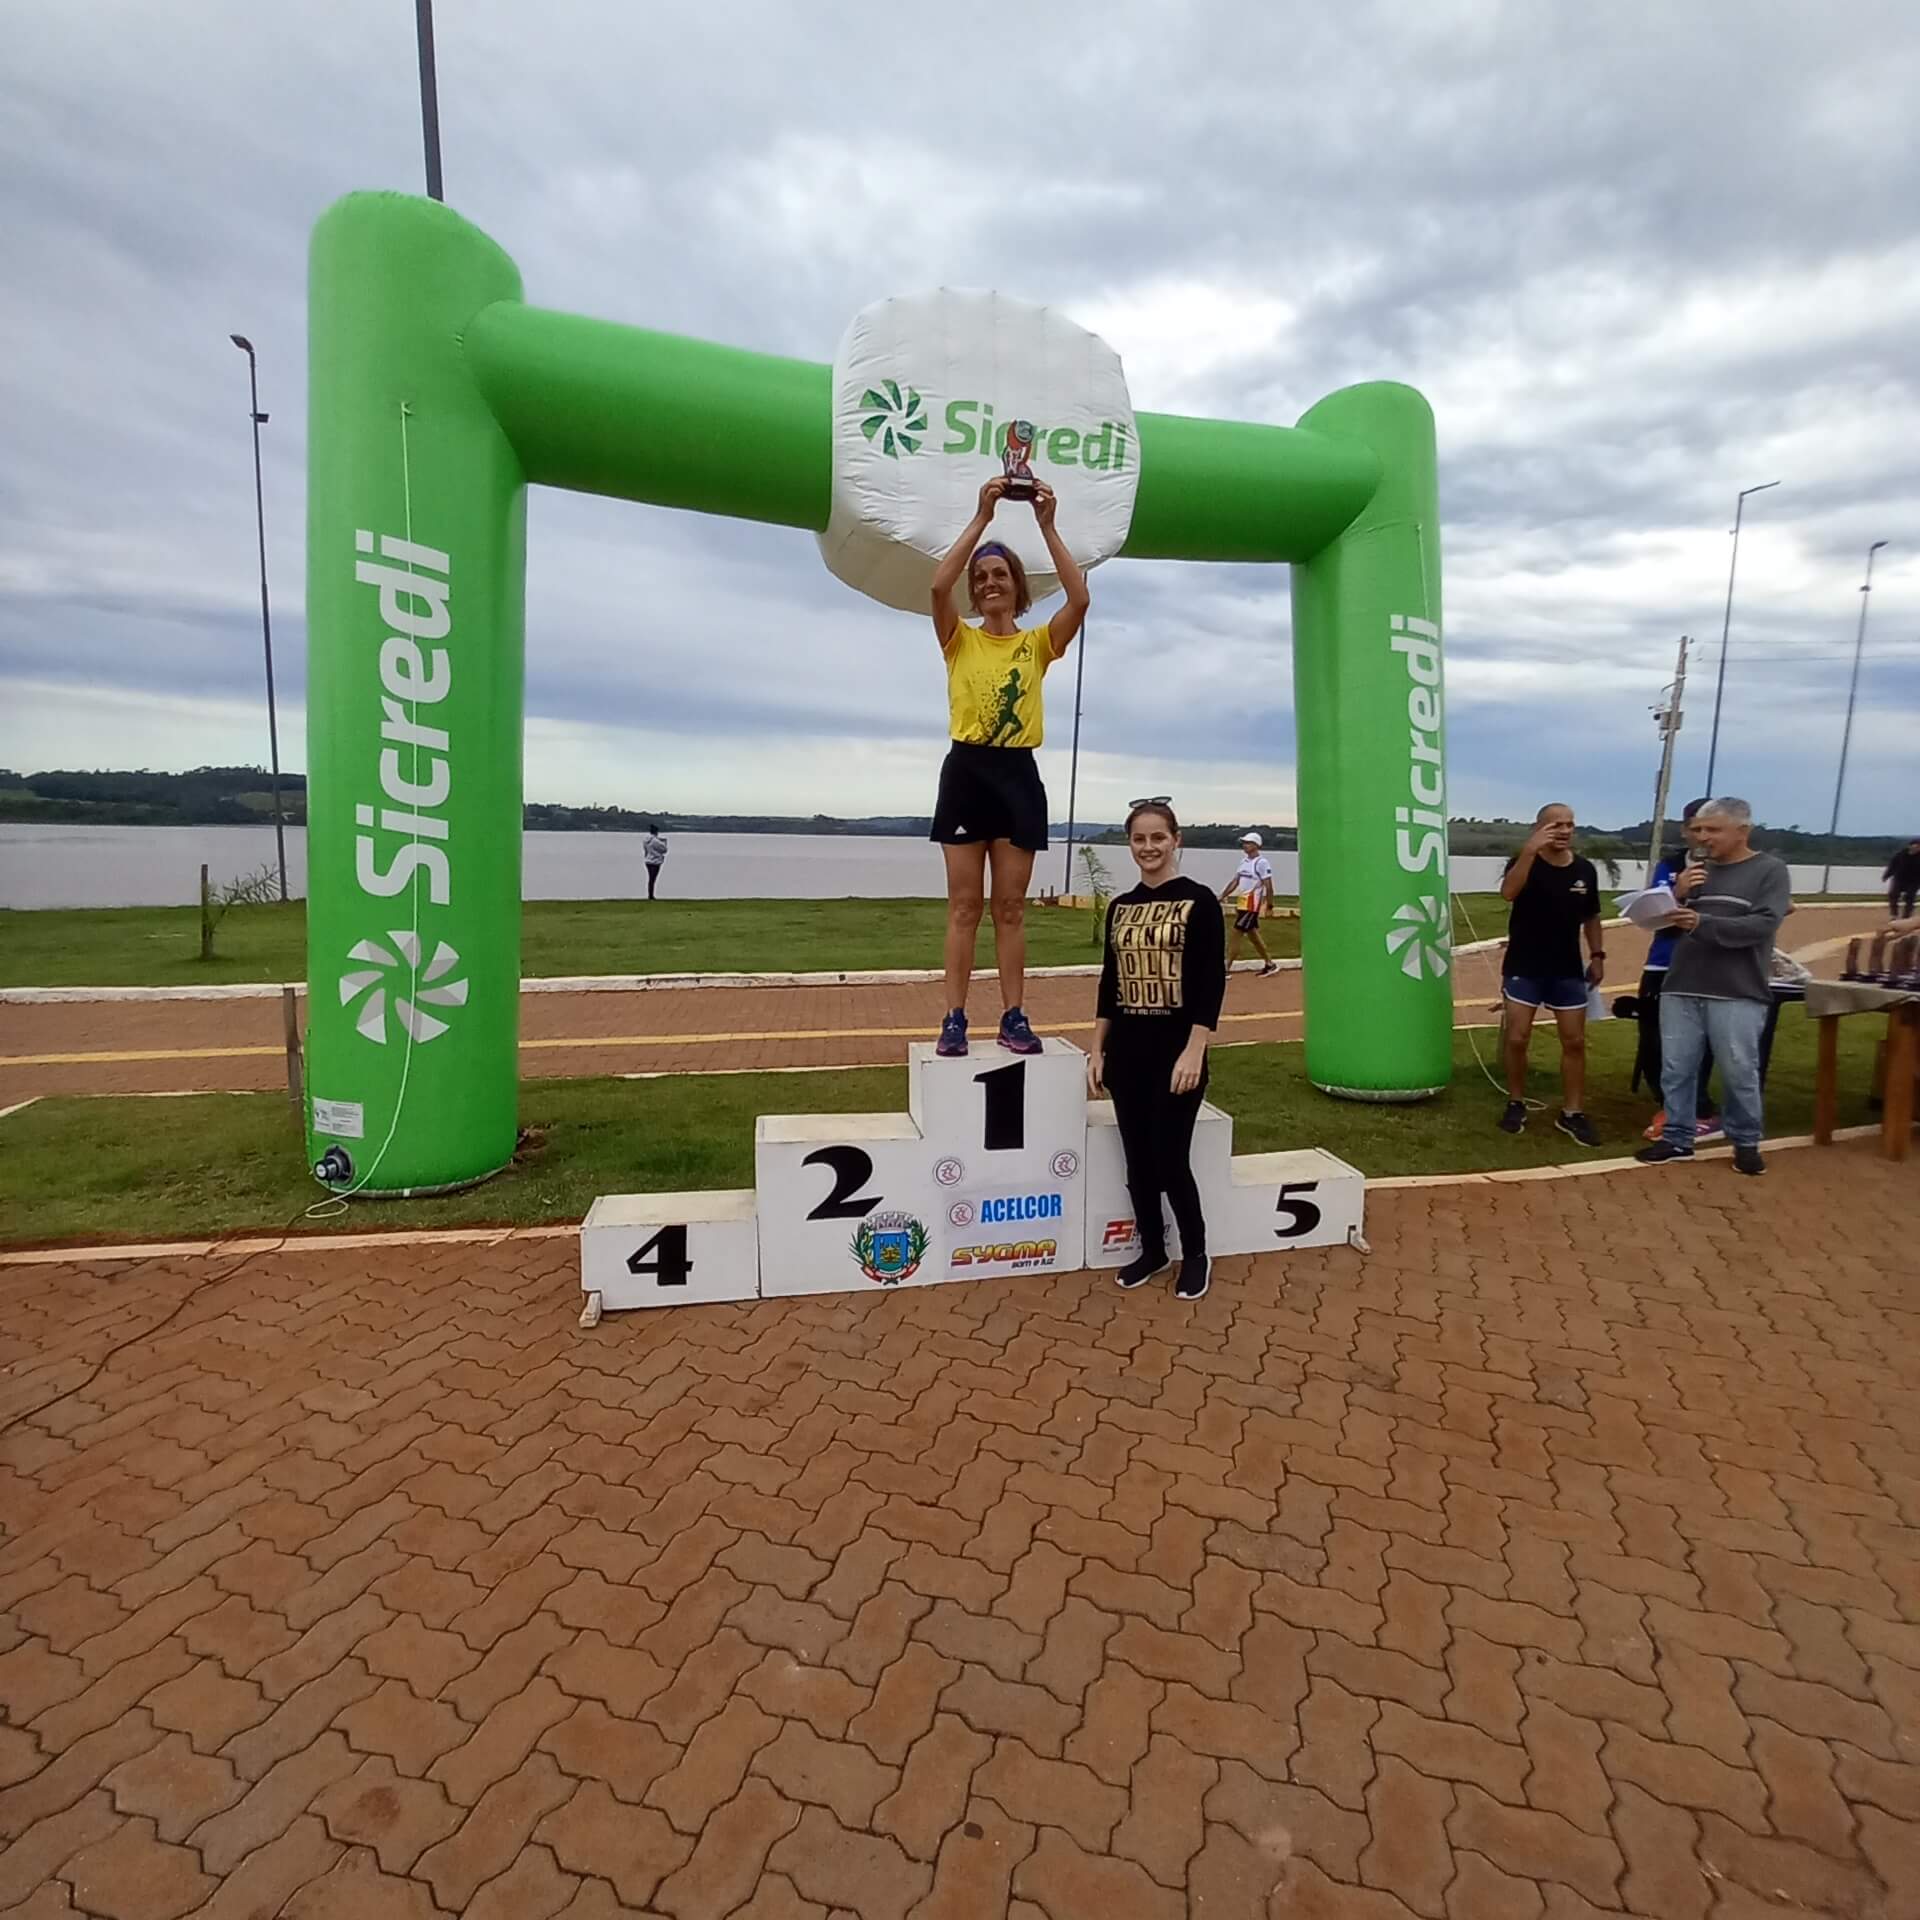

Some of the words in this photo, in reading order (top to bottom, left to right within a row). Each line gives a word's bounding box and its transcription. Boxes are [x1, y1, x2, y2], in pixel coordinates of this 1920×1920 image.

[356, 529, 452, 905] Sicredi
[1390, 614, 1445, 876] Sicredi
[1114, 902, 1187, 924] ROCK
[1122, 924, 1182, 947] AND
[973, 1059, 1025, 1150] 1
[801, 1145, 884, 1221] 2
[981, 1194, 1062, 1223] ACELCOR
[1274, 1182, 1321, 1238] 5
[626, 1224, 694, 1287] 4
